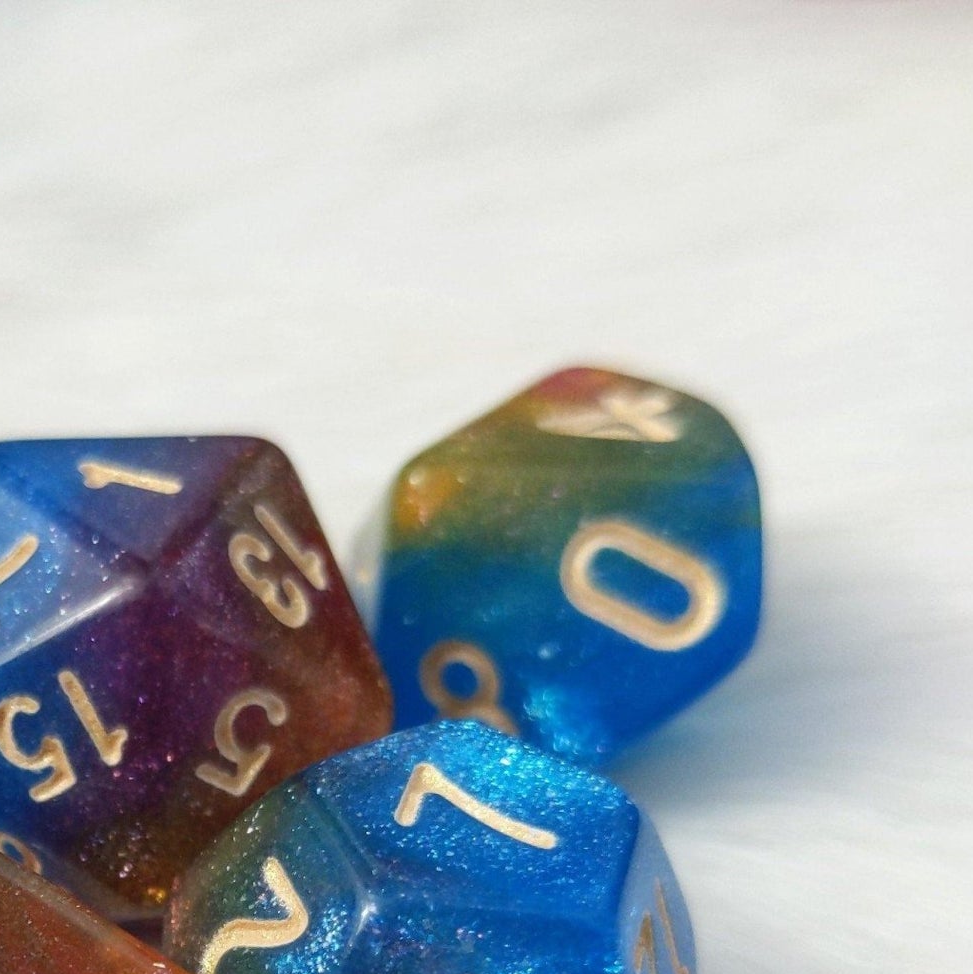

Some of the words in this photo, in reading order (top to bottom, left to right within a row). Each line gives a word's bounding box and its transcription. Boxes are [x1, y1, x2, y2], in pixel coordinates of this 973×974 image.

[78, 459, 183, 495] 1
[229, 504, 327, 629] 13
[560, 520, 722, 652] 0
[195, 690, 287, 795] 5
[394, 762, 558, 850] 7
